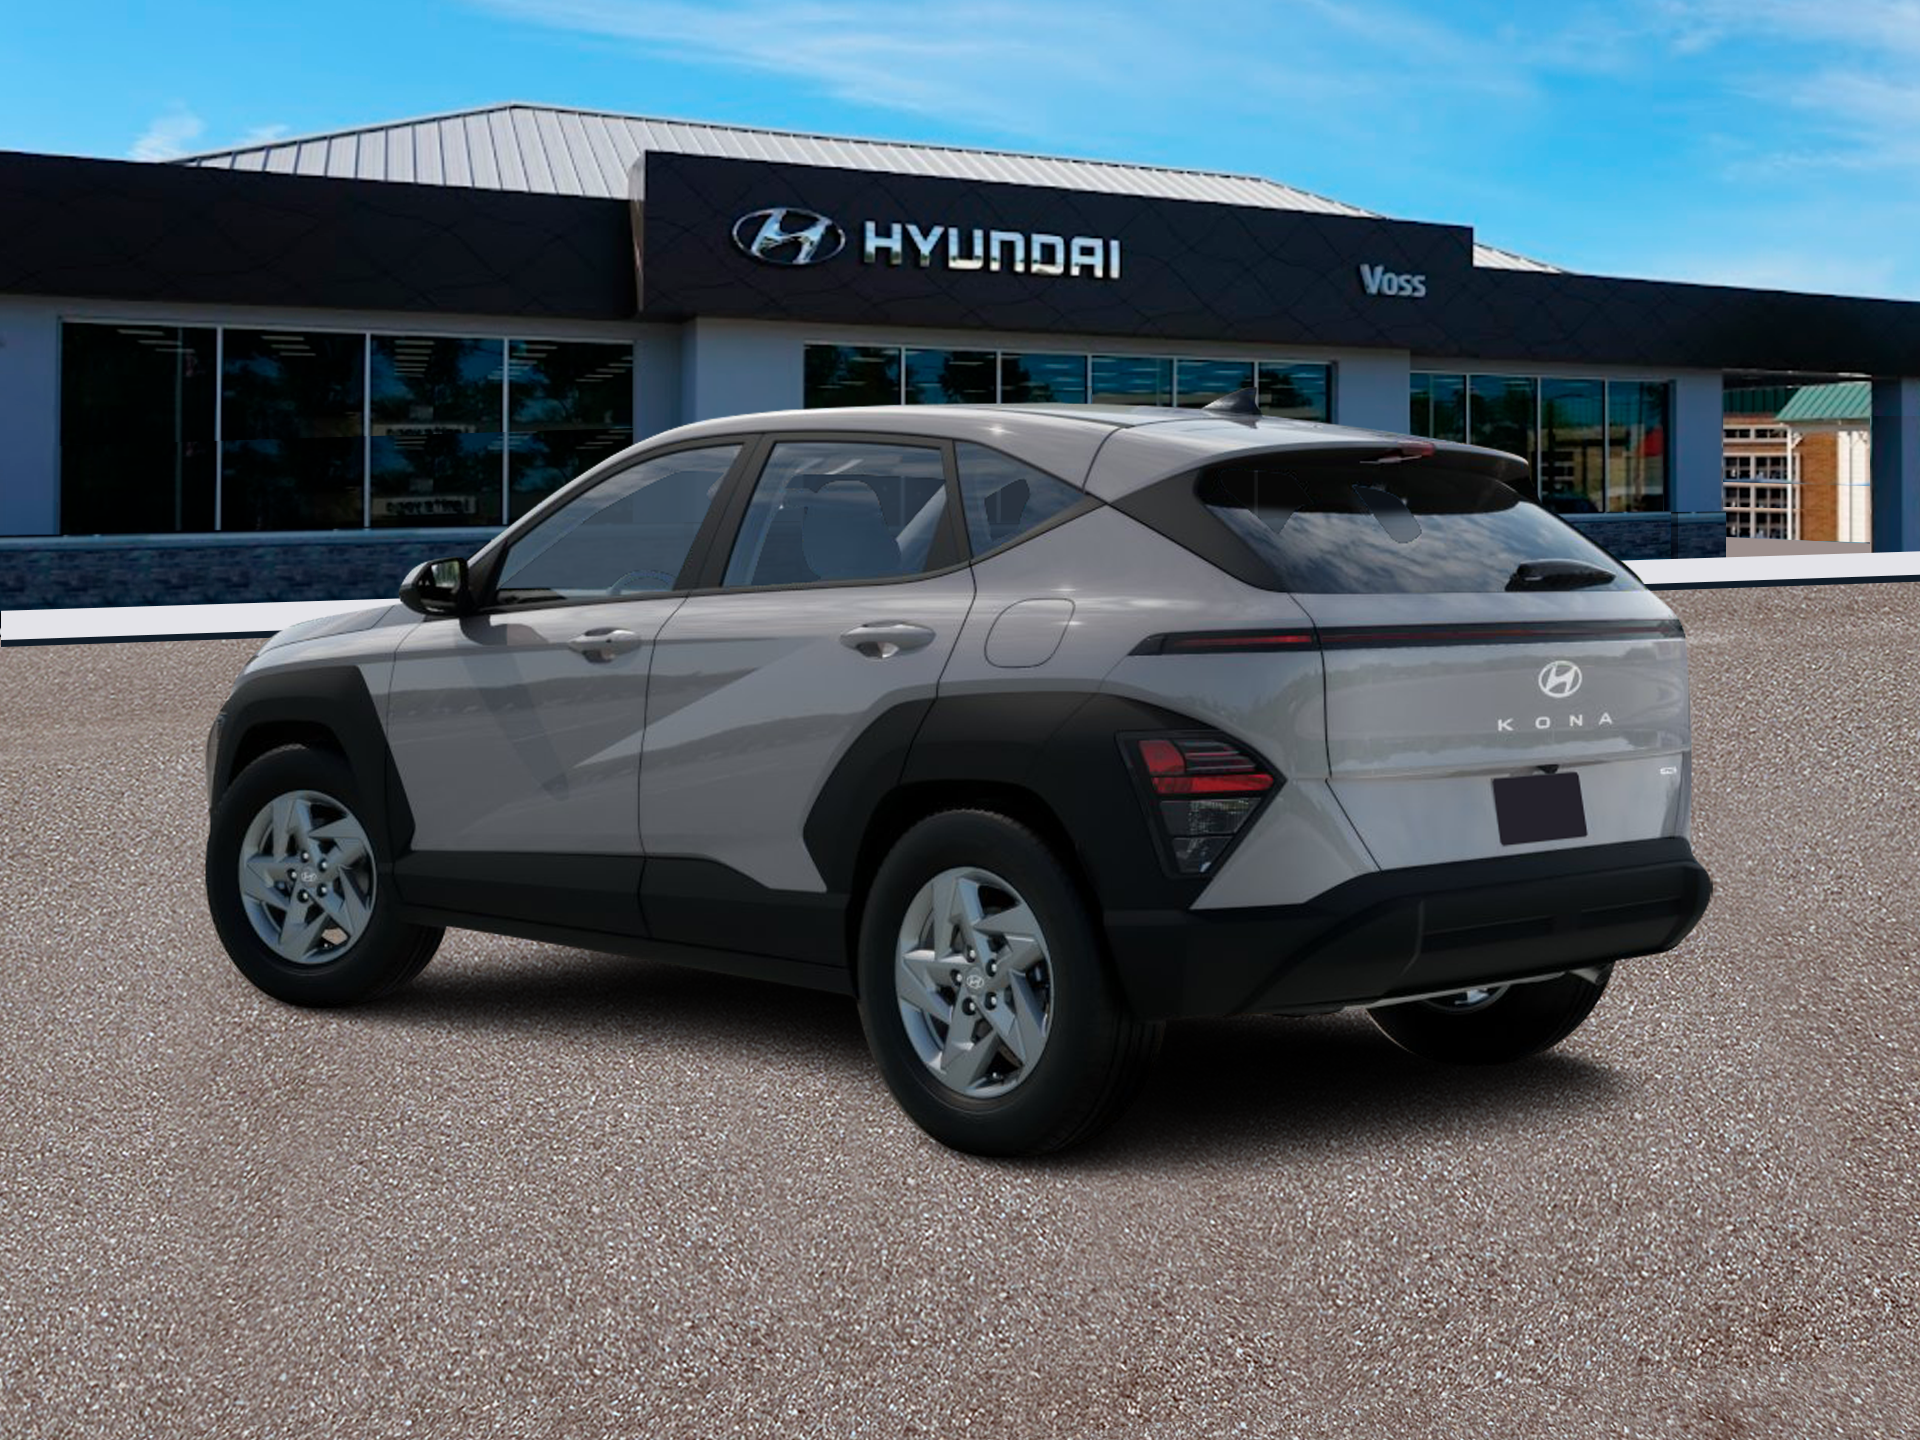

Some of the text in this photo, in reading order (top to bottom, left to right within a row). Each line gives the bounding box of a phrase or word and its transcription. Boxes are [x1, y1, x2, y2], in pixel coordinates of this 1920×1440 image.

[864, 220, 1121, 279] HYUNDAI
[1360, 263, 1426, 298] Voss
[1497, 712, 1613, 732] KONA
